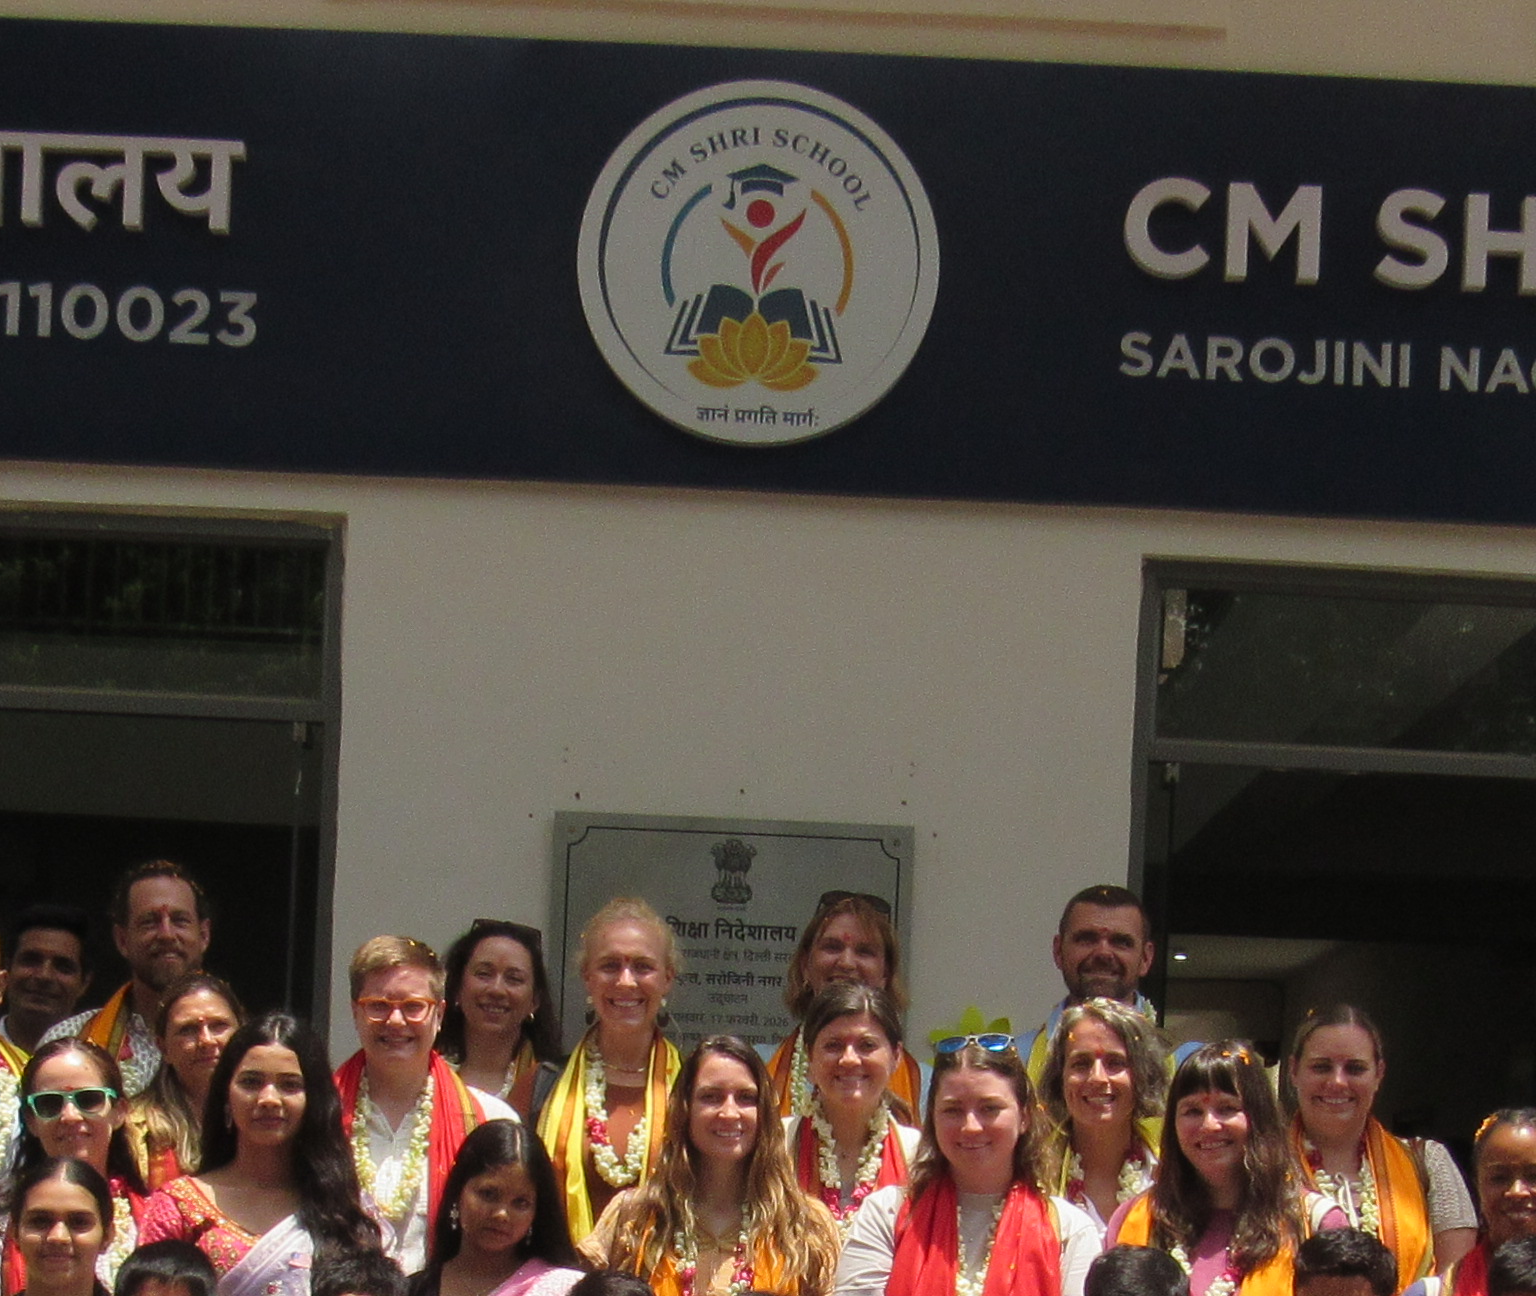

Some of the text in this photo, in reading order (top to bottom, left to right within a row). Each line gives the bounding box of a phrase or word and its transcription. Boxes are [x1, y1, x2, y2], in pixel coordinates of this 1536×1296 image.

[648, 126, 874, 213] CM SHRI SCHOOL
[1122, 177, 1324, 283] CM
[1118, 331, 1412, 388] SAROJINI
[734, 405, 778, 425] प्रगति
[714, 917, 798, 942] निदेशालय
[705, 970, 755, 987] सरोजिनी
[757, 974, 783, 987] नगर
